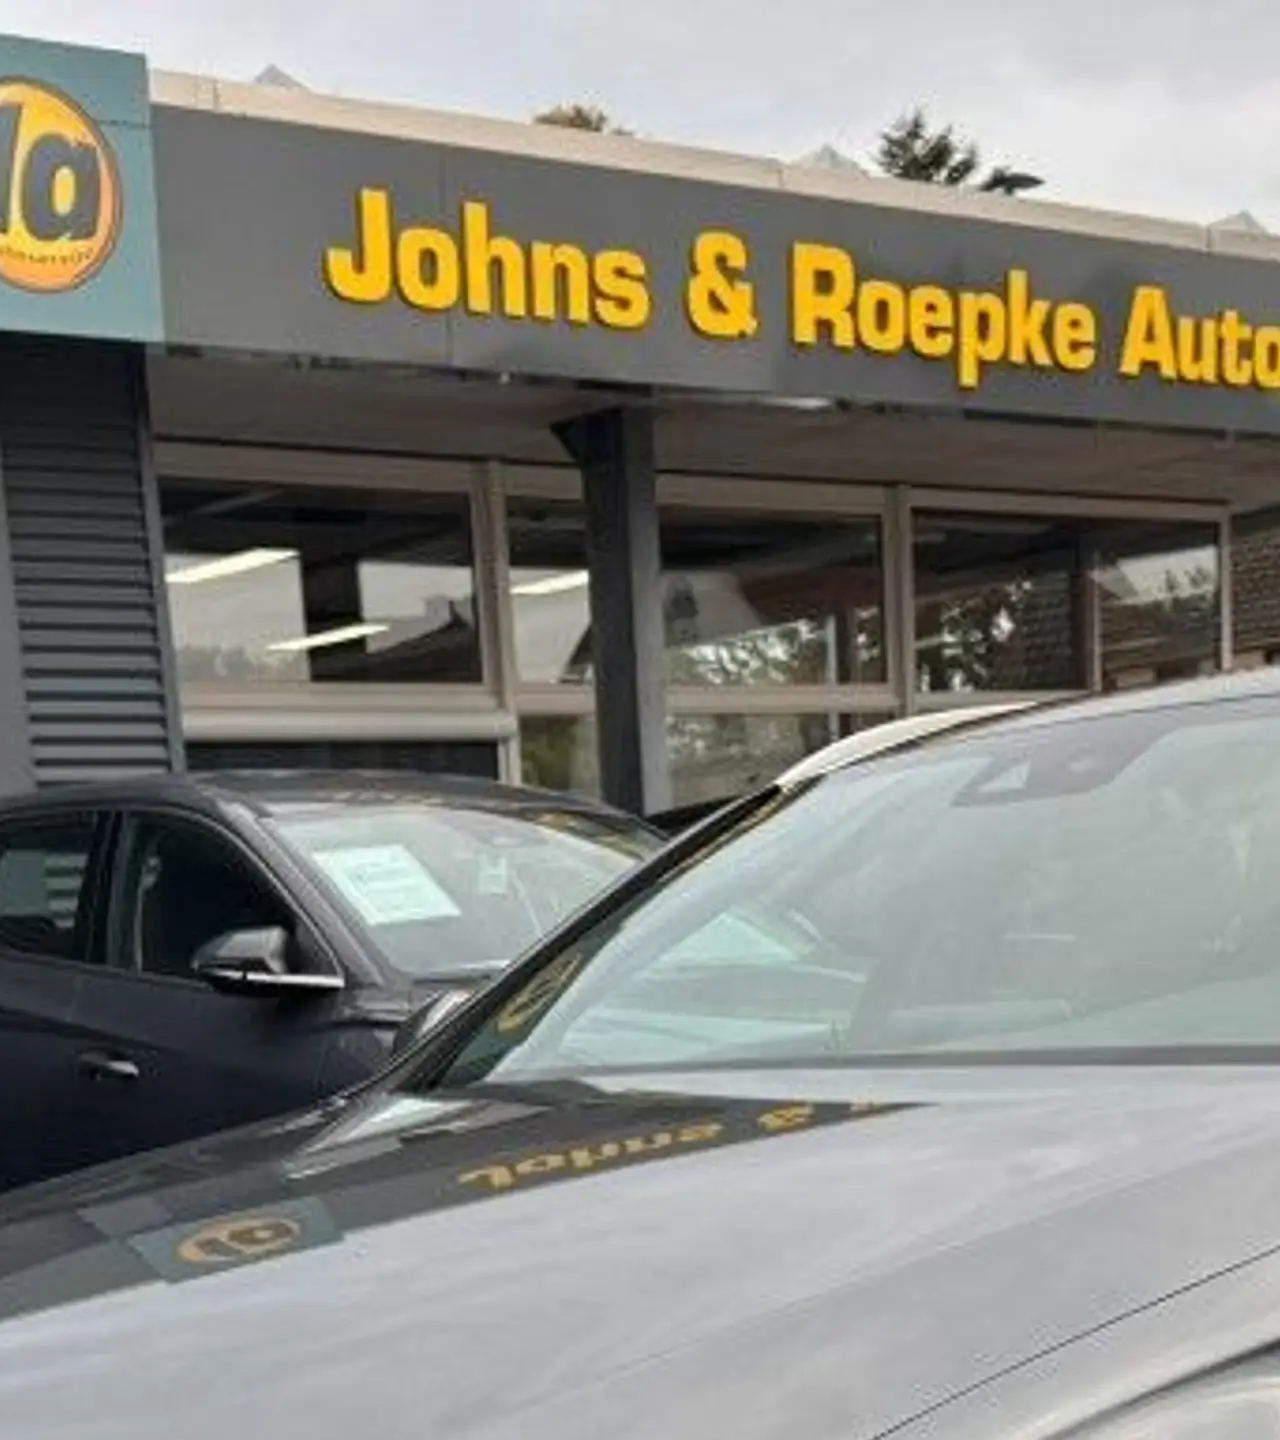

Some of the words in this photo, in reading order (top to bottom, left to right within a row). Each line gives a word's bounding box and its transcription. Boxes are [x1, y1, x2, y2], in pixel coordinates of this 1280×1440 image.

[325, 187, 653, 330] Johns
[686, 229, 760, 340] &
[791, 241, 1097, 389] Roepke
